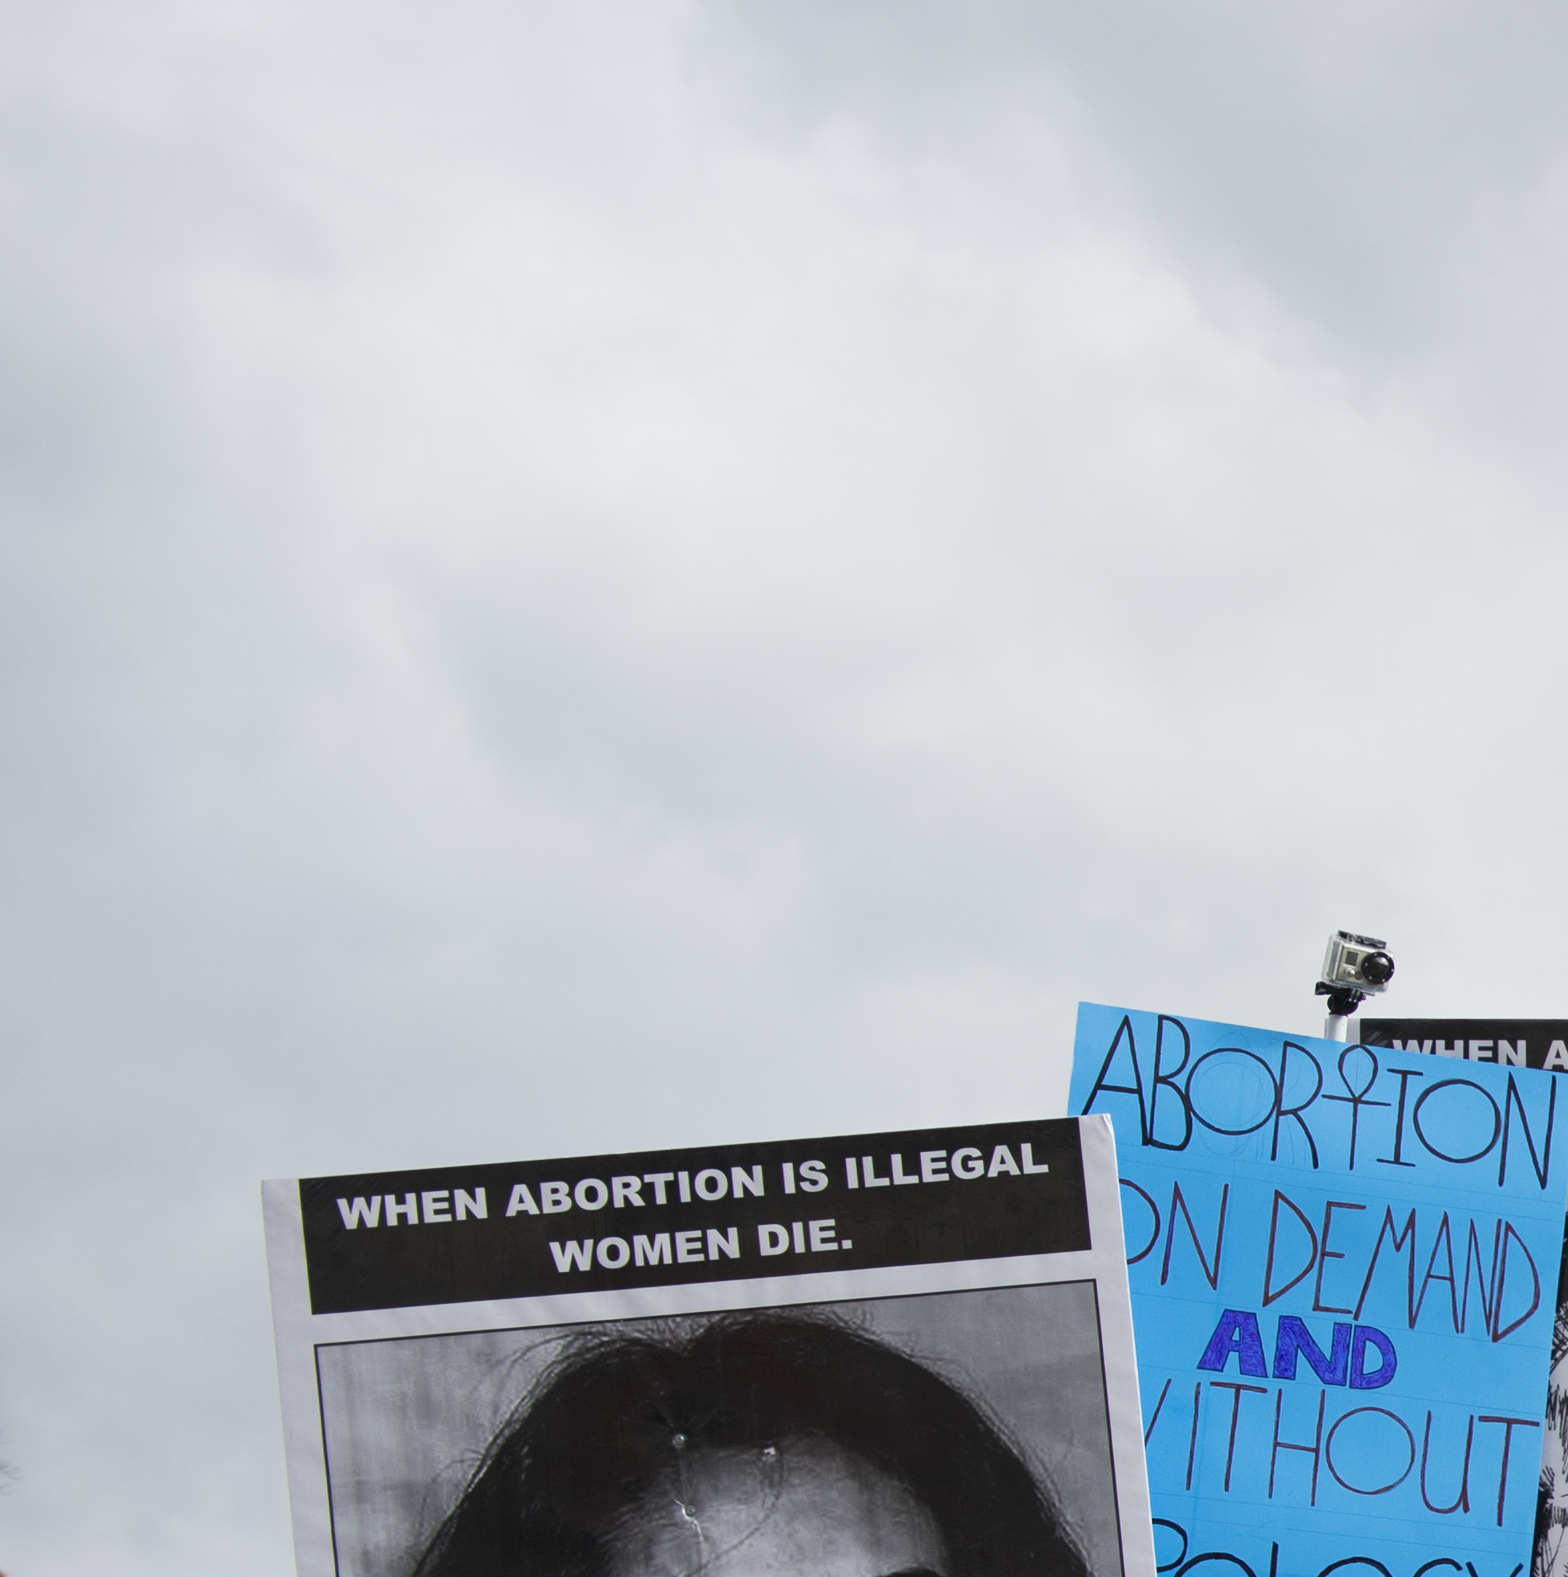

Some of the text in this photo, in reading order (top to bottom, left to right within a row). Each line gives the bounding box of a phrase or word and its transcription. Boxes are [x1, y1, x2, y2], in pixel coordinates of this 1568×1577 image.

[1081, 1013, 1557, 1190] ABORTION
[337, 1142, 1049, 1229] WHEN ABORTION IS ILLEGAL
[550, 1217, 853, 1273] WOMEN DIE.
[1262, 1188, 1541, 1343] DEMAND
[1197, 1308, 1397, 1390] AND
